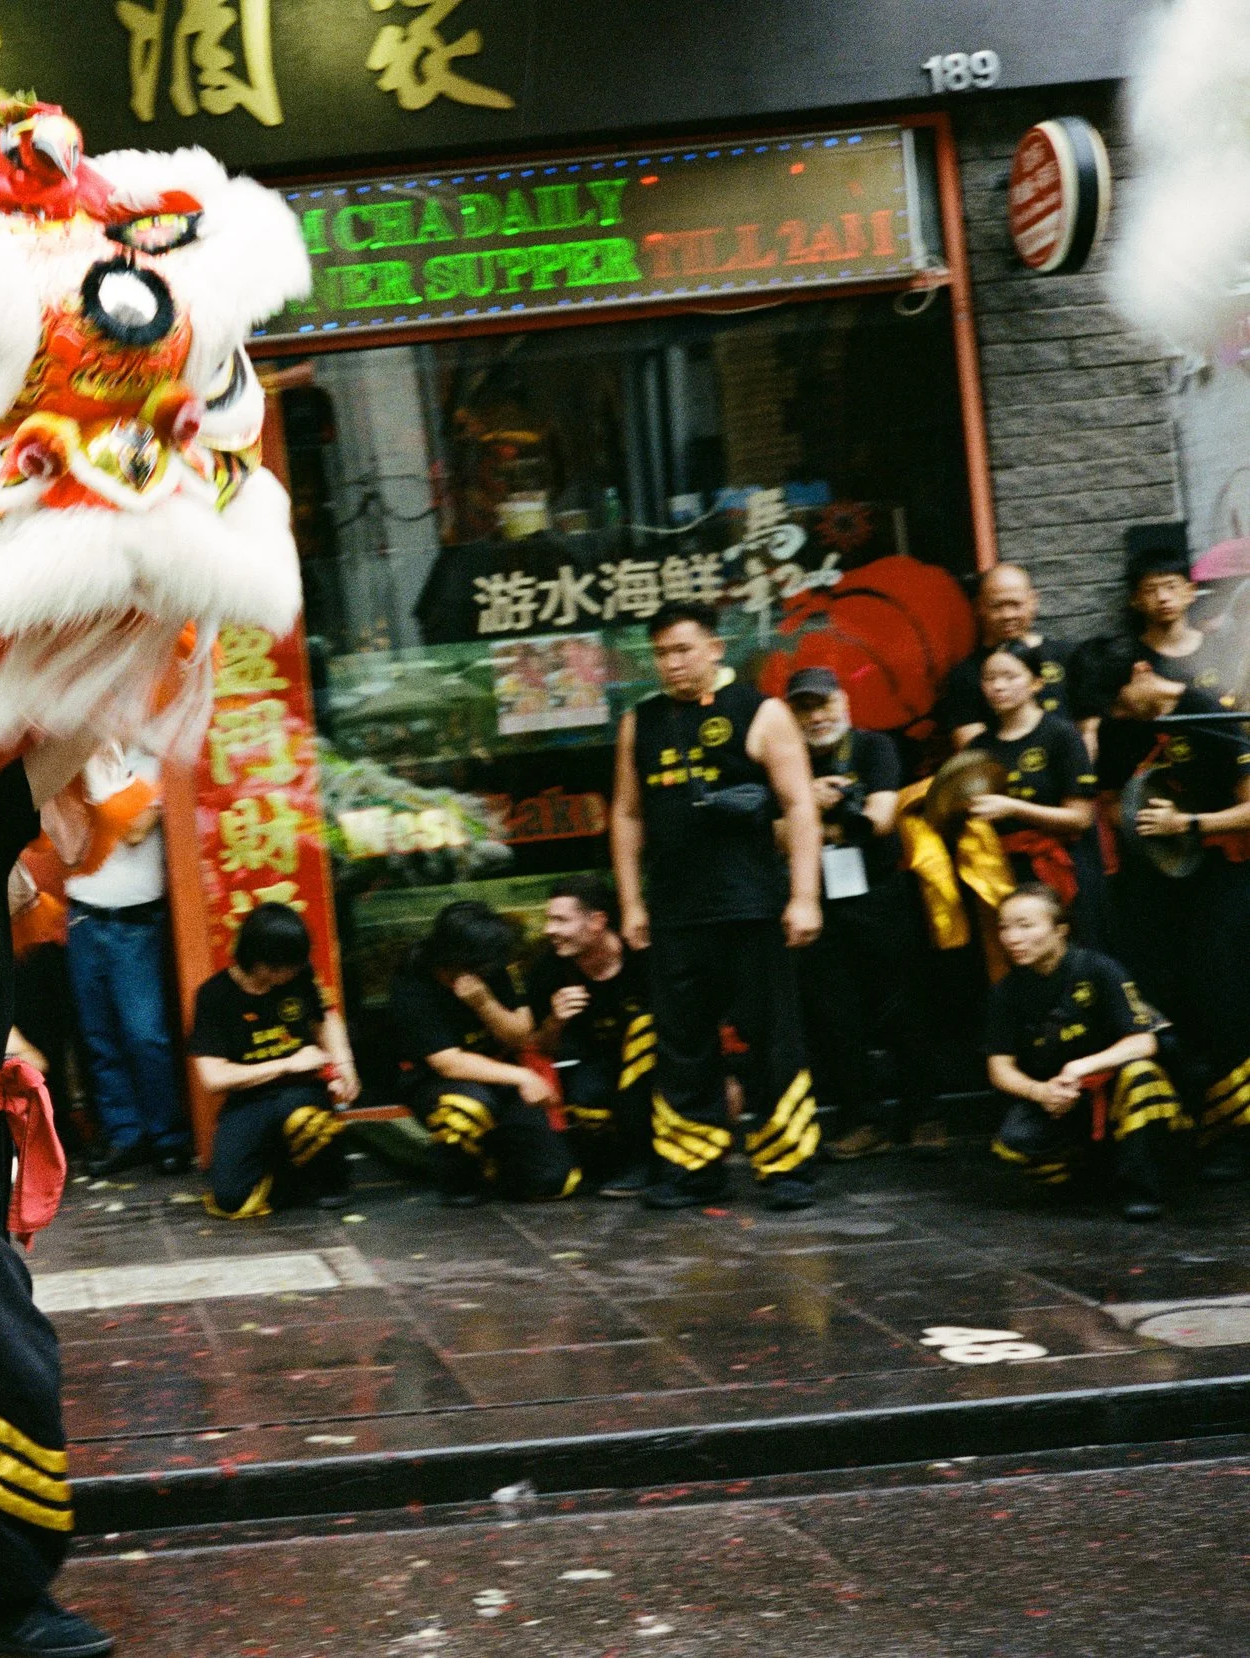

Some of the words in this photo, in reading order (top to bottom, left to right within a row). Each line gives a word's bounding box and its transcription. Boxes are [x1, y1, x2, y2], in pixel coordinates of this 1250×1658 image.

[921, 50, 1000, 93] 189
[332, 196, 456, 252] CHA
[459, 178, 631, 239] DAILY
[424, 237, 642, 301] SUPPER
